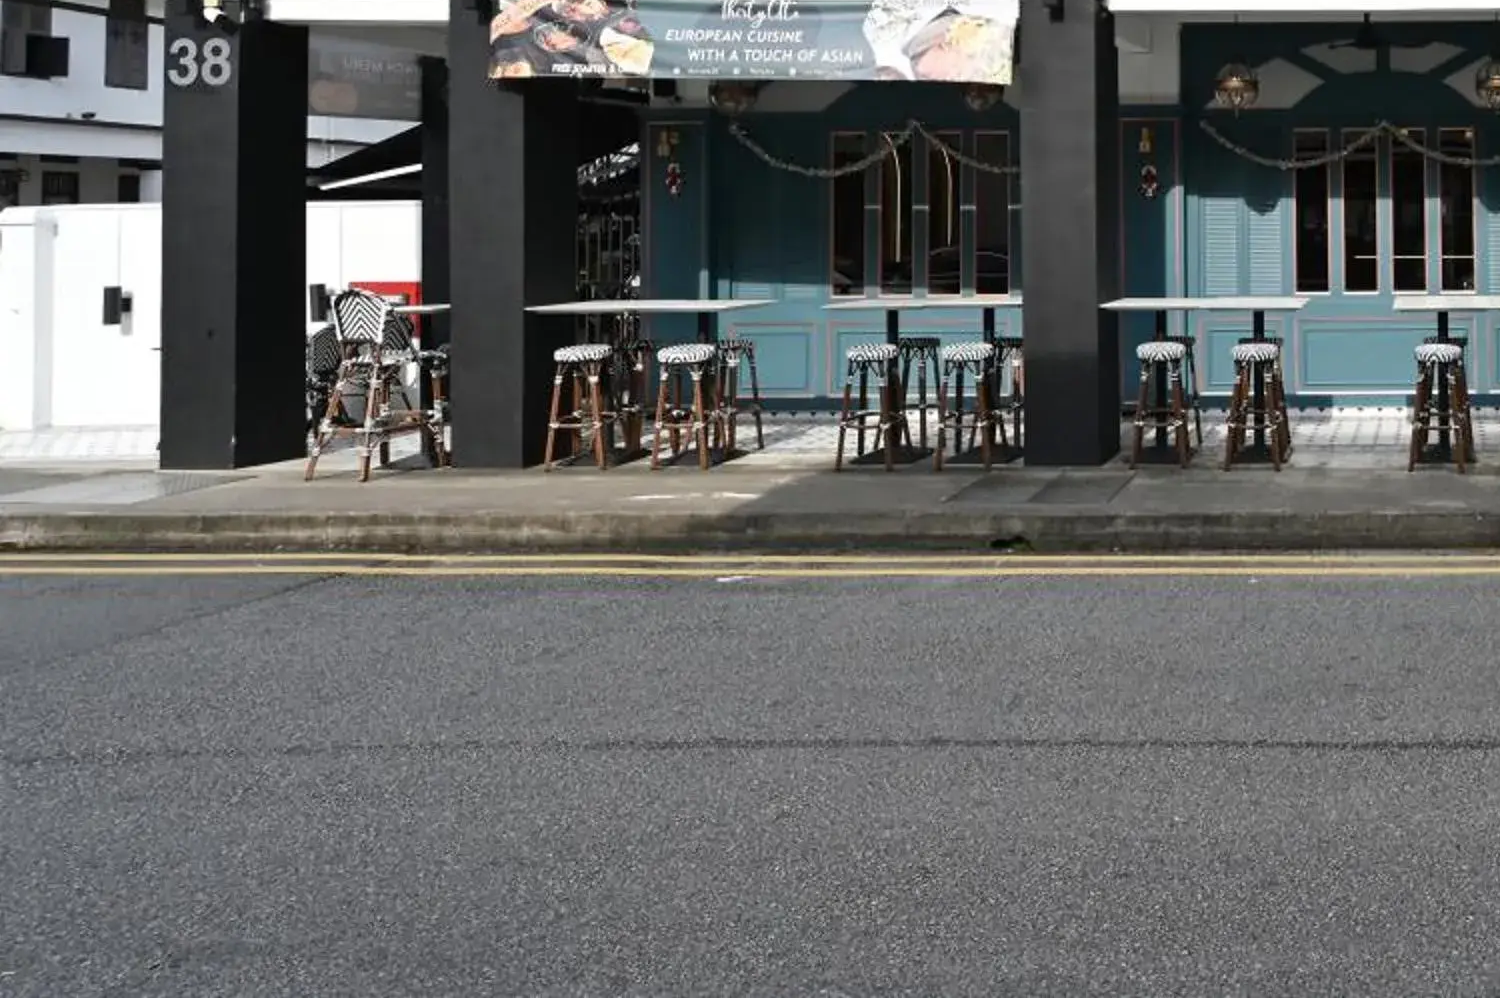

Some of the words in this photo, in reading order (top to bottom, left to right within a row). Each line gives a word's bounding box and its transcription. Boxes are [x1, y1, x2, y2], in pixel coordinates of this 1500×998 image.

[665, 29, 743, 43] EUROPEAN
[746, 29, 804, 44] CUISINE
[167, 36, 233, 87] 38
[687, 48, 726, 63] WITH
[728, 48, 739, 63] A
[743, 48, 793, 63] TOUCH
[796, 48, 818, 64] OF
[820, 49, 863, 65] ASIAN
